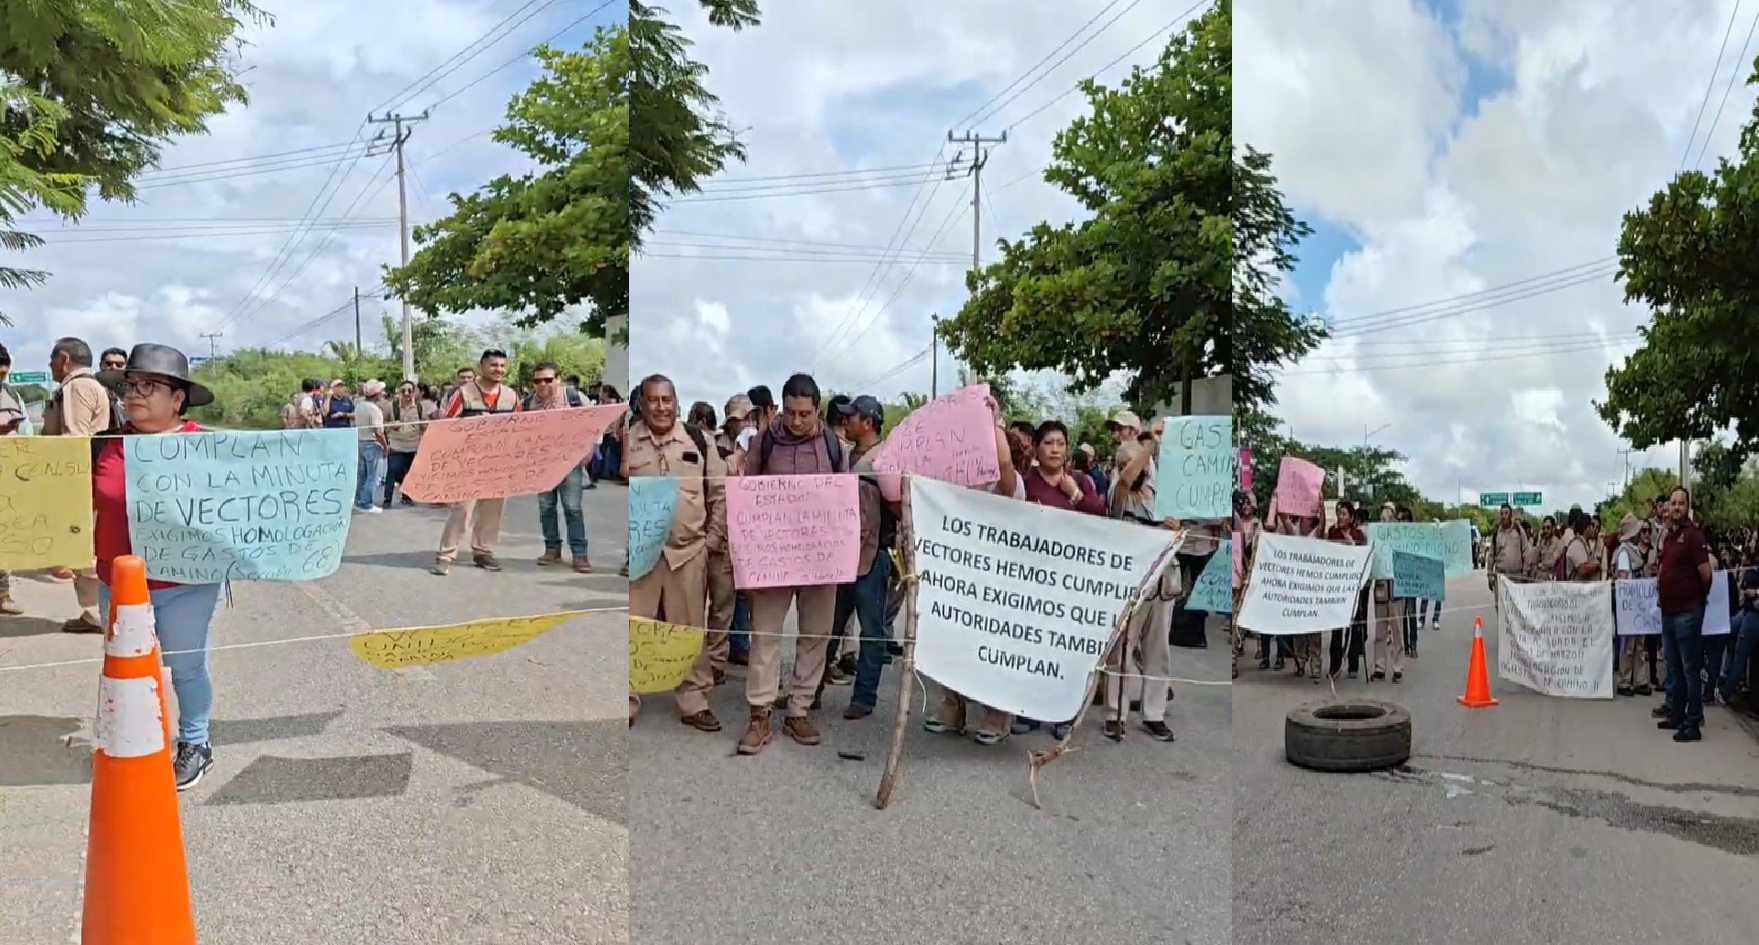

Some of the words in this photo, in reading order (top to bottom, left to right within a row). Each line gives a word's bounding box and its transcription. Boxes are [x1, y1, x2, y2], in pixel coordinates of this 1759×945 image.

[136, 472, 191, 493] CON
[207, 470, 241, 489] LA
[251, 462, 348, 487] MINUTA
[136, 500, 168, 524] DE
[175, 488, 342, 526] VECTORES
[942, 515, 972, 536] LOS
[977, 524, 1106, 566] TRABAJADORES
[1110, 554, 1133, 572] DE
[1377, 526, 1425, 541] GASTOS
[143, 545, 172, 561] DE
[181, 545, 277, 562] GASTOS
[914, 537, 991, 571] VECTORES
[996, 559, 1057, 587] HEMOS
[1274, 549, 1287, 560] LOS
[1289, 552, 1344, 568] TRABAJADORES
[1345, 560, 1355, 568] DE
[1259, 562, 1294, 575] VECTORES
[1296, 569, 1323, 580] HEMOS
[1261, 577, 1287, 588] AHORA
[1288, 581, 1325, 592] EXIGIMOS
[1326, 585, 1341, 594] QUE
[920, 569, 978, 600] AHORA
[983, 586, 1065, 618] EXIGIMOS
[1070, 605, 1107, 627] QUE
[1262, 592, 1313, 605] AUTORIDADES
[931, 601, 1042, 644] AUTORIDADES
[1048, 630, 1107, 656] TAMBI
[978, 645, 1064, 680] CUMPLAN.
